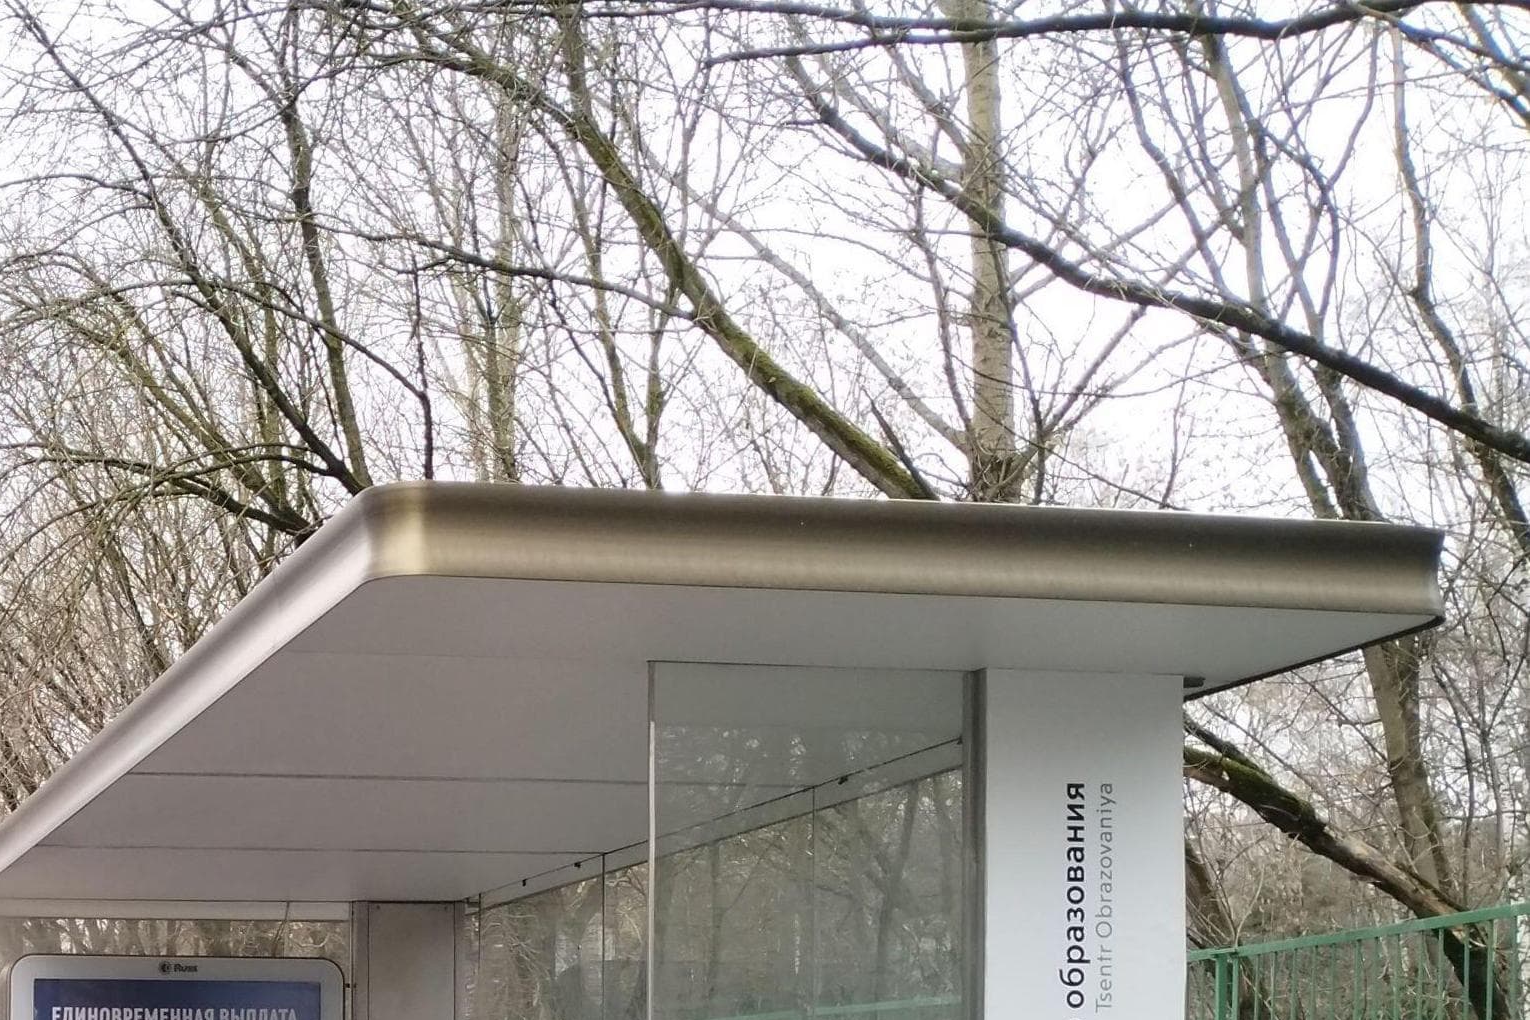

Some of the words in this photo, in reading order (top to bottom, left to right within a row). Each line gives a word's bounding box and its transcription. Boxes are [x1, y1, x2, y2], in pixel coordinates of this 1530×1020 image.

[1058, 782, 1091, 1009] образования
[1095, 782, 1118, 939] Obrazovaniya
[1095, 945, 1113, 1013] Tsentr
